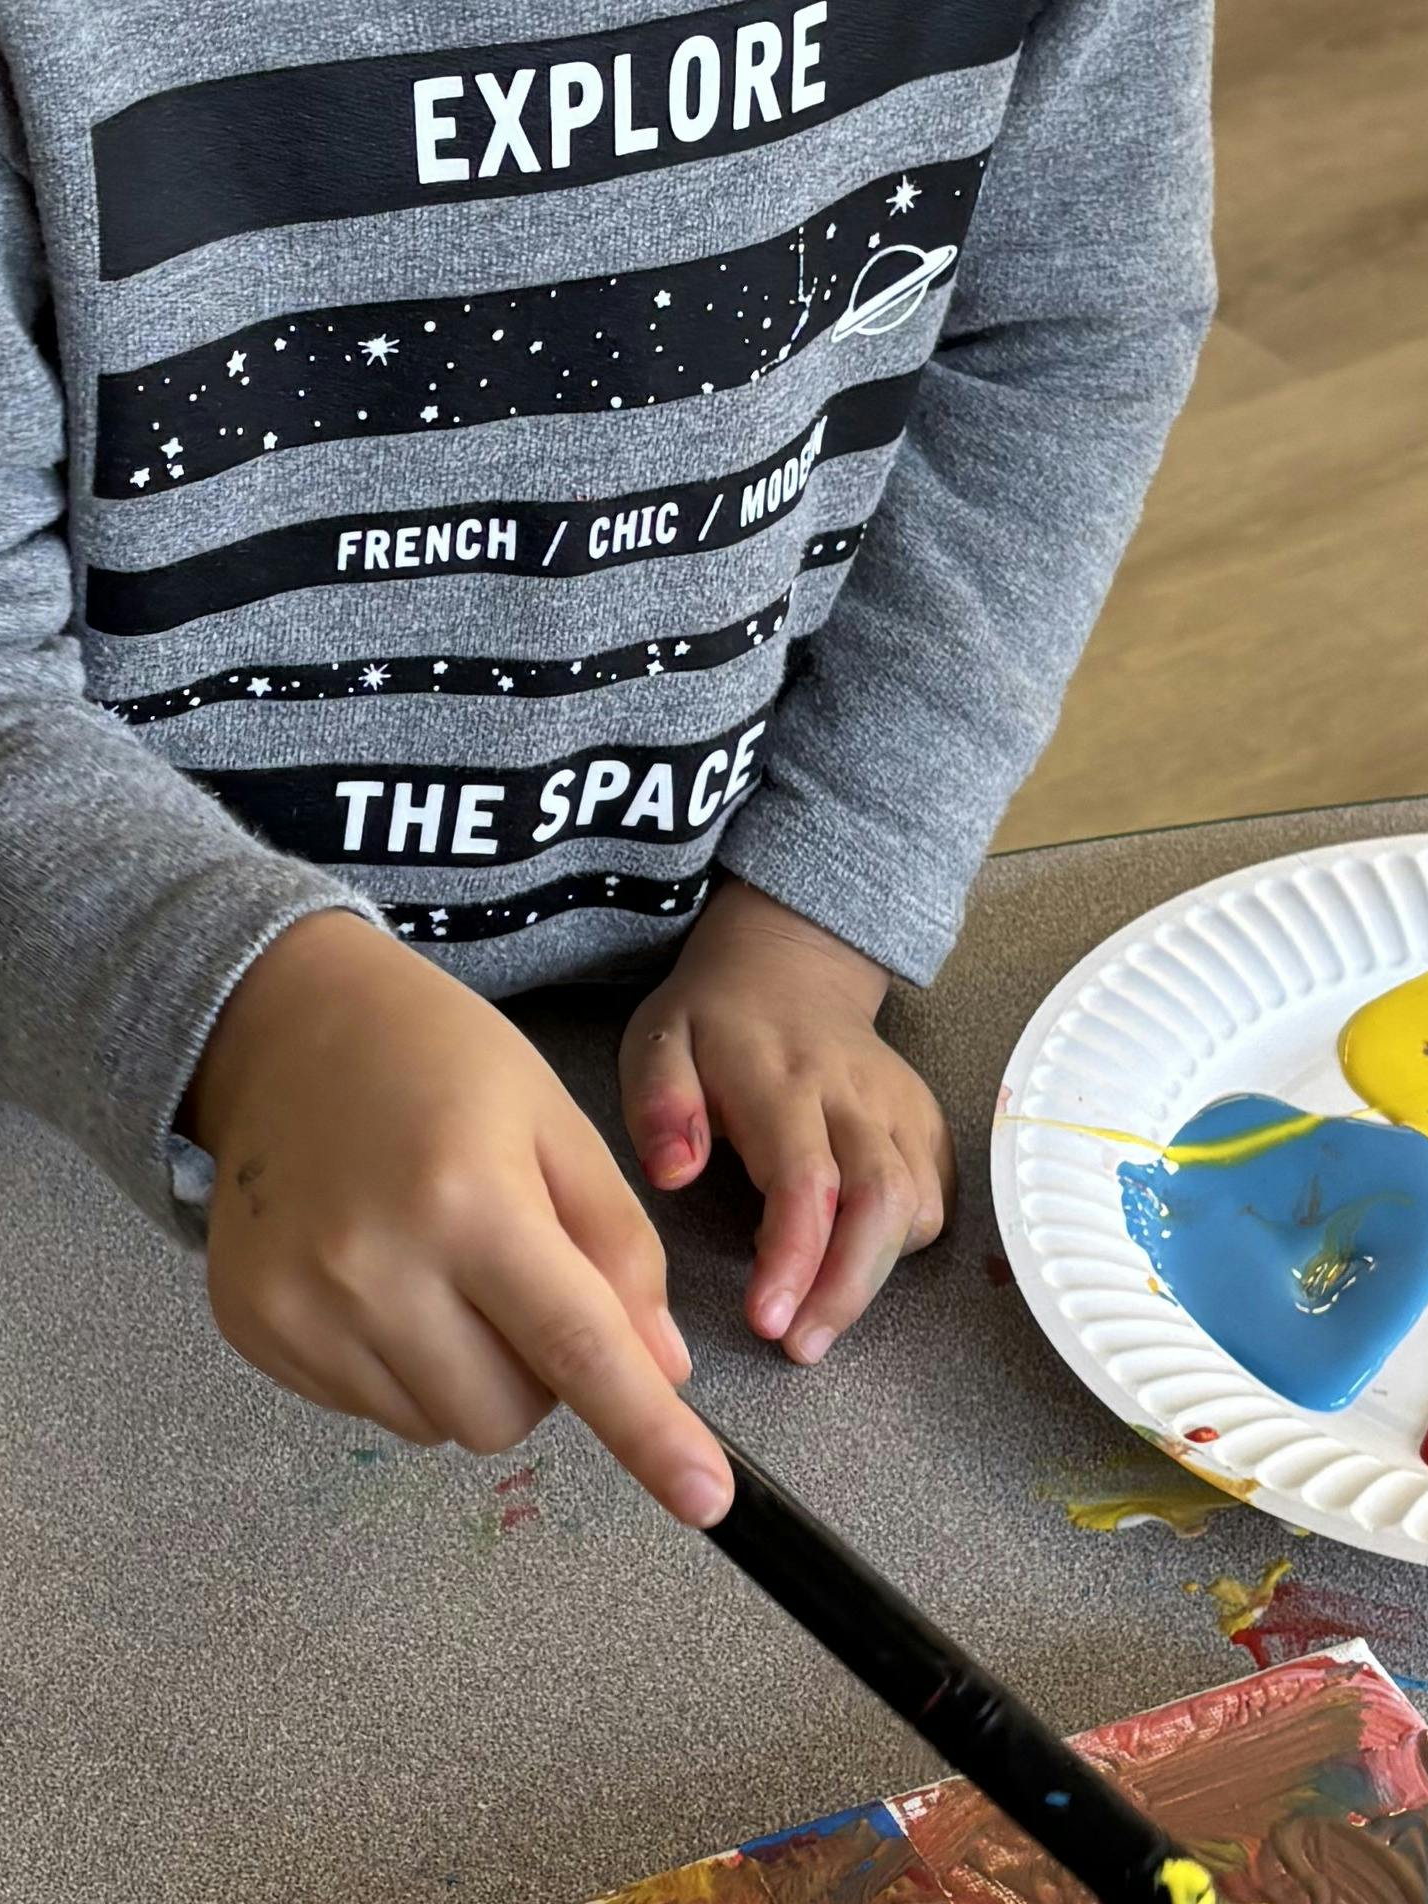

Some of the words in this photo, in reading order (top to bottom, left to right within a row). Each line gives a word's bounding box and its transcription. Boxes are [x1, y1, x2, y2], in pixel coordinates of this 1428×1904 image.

[413, 0, 828, 184] EXPLORE
[337, 517, 517, 572] FRENCH
[588, 501, 679, 559] CHIC
[335, 781, 506, 856] THE
[531, 720, 766, 843] SPACE
